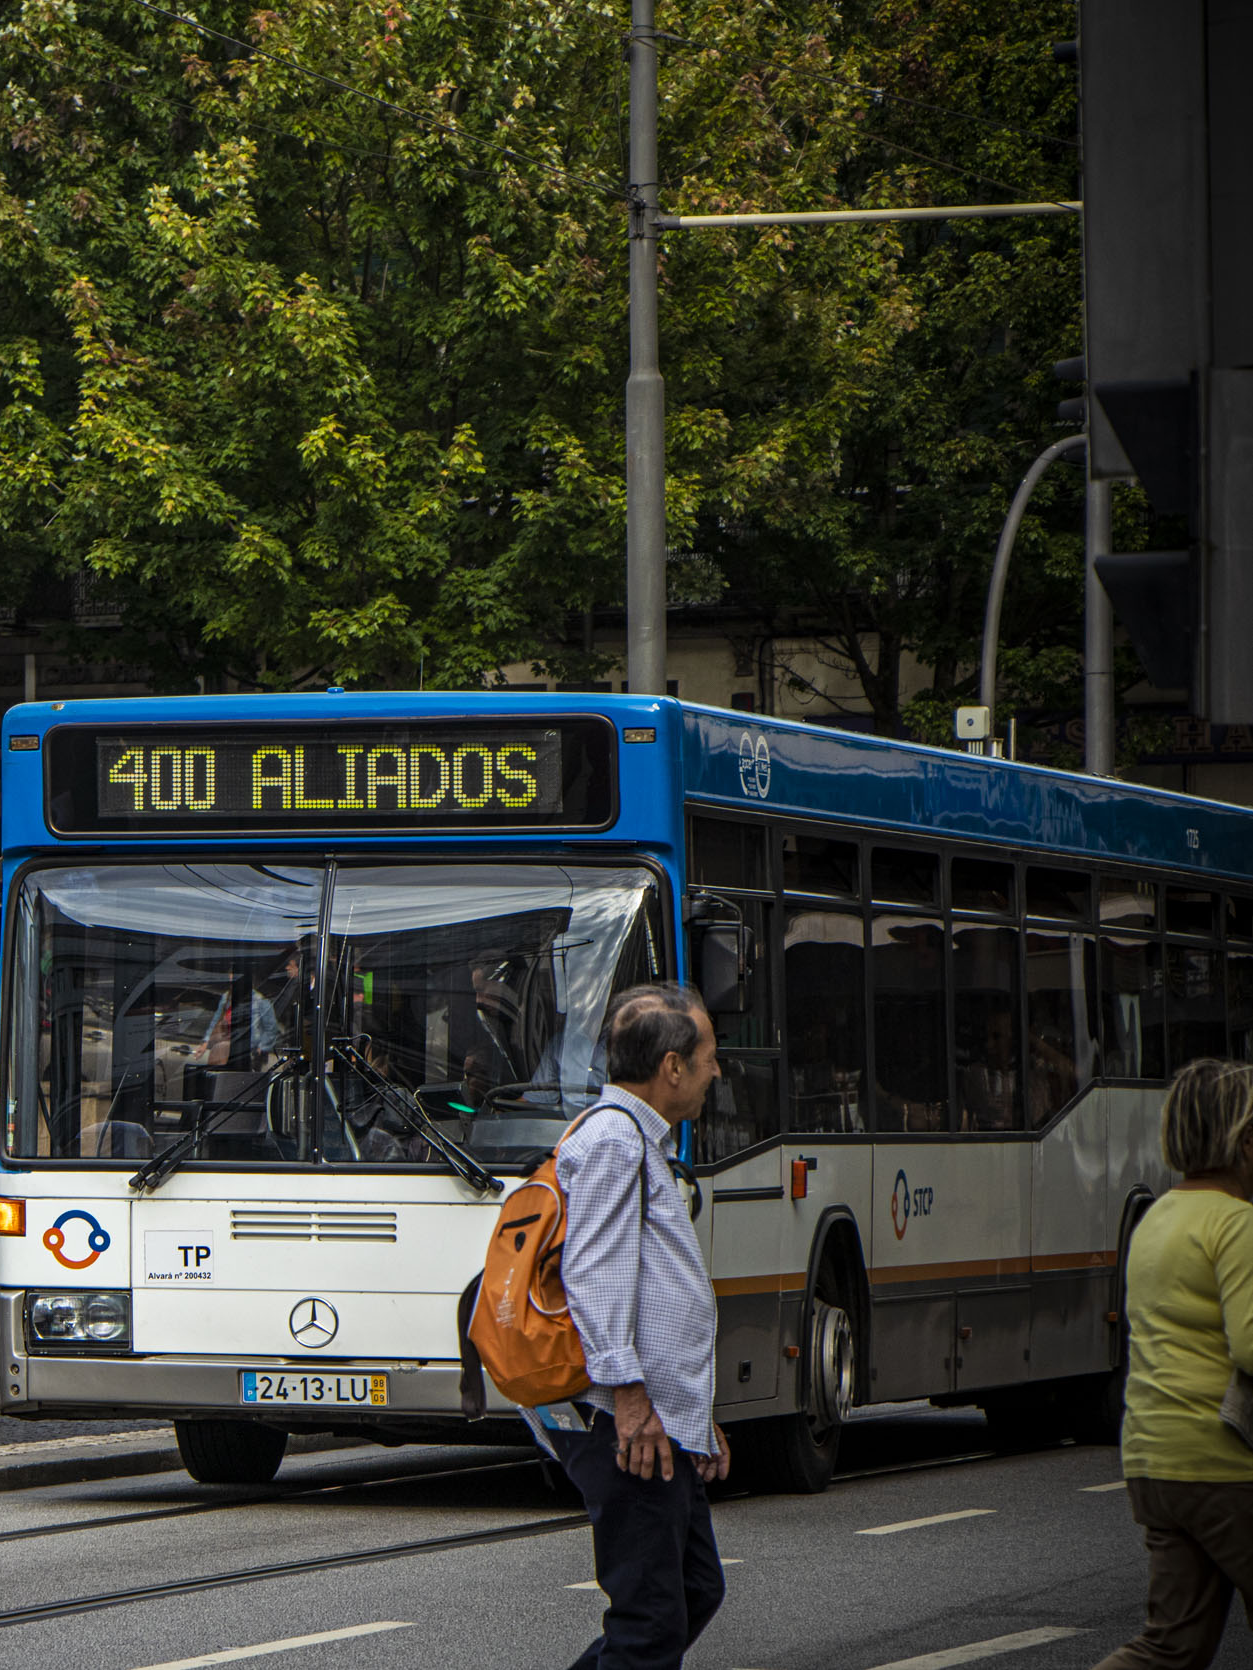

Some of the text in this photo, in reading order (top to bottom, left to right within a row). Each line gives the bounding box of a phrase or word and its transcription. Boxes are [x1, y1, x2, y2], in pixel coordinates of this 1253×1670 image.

[108, 743, 538, 810] 400 ALIADOS
[913, 1187, 933, 1216] STCP
[178, 1246, 211, 1267] TP
[148, 1271, 173, 1280] Alvará
[185, 1272, 211, 1280] 200432
[373, 1379, 384, 1387] 98
[373, 1394, 384, 1402] 09
